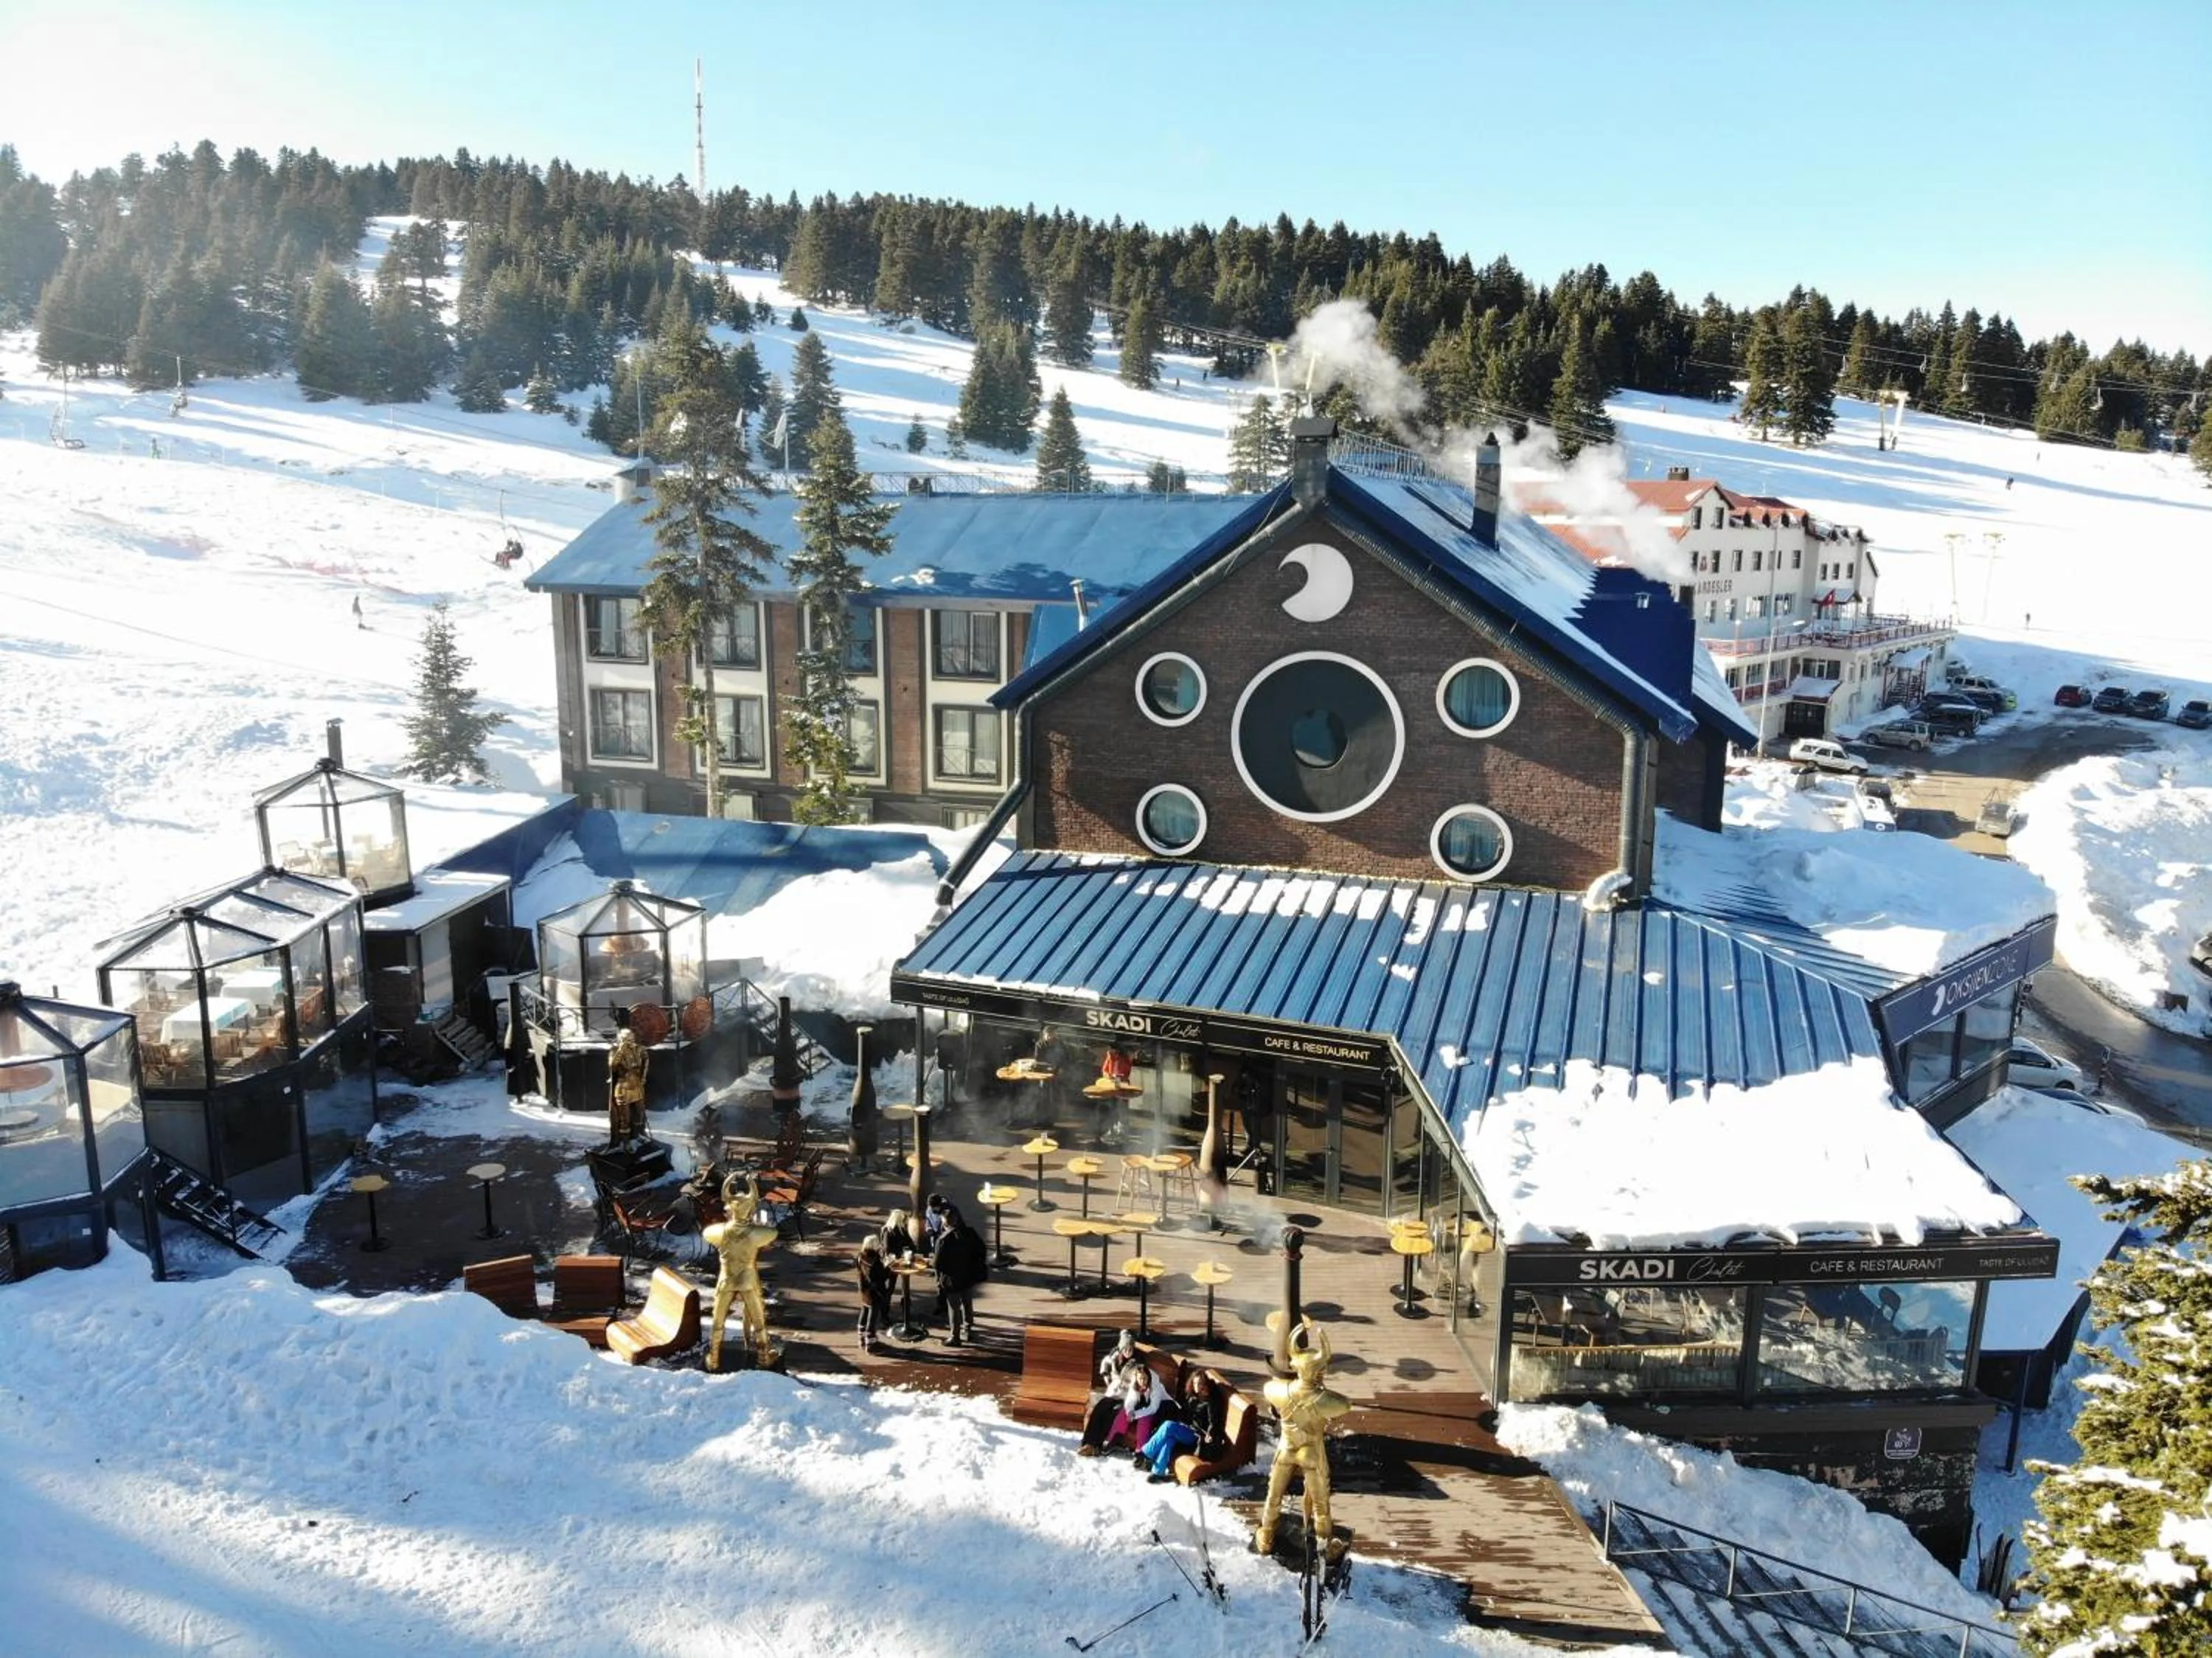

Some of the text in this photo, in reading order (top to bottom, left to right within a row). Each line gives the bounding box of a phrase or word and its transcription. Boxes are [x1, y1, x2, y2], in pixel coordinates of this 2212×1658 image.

[1085, 1009, 1152, 1033] SKADI
[1264, 1036, 1371, 1061] CAFE & RESTAURANT
[1579, 1255, 1746, 1282] SKADI Chalet
[1810, 1258, 1944, 1273] CAFE & RESTAURANT
